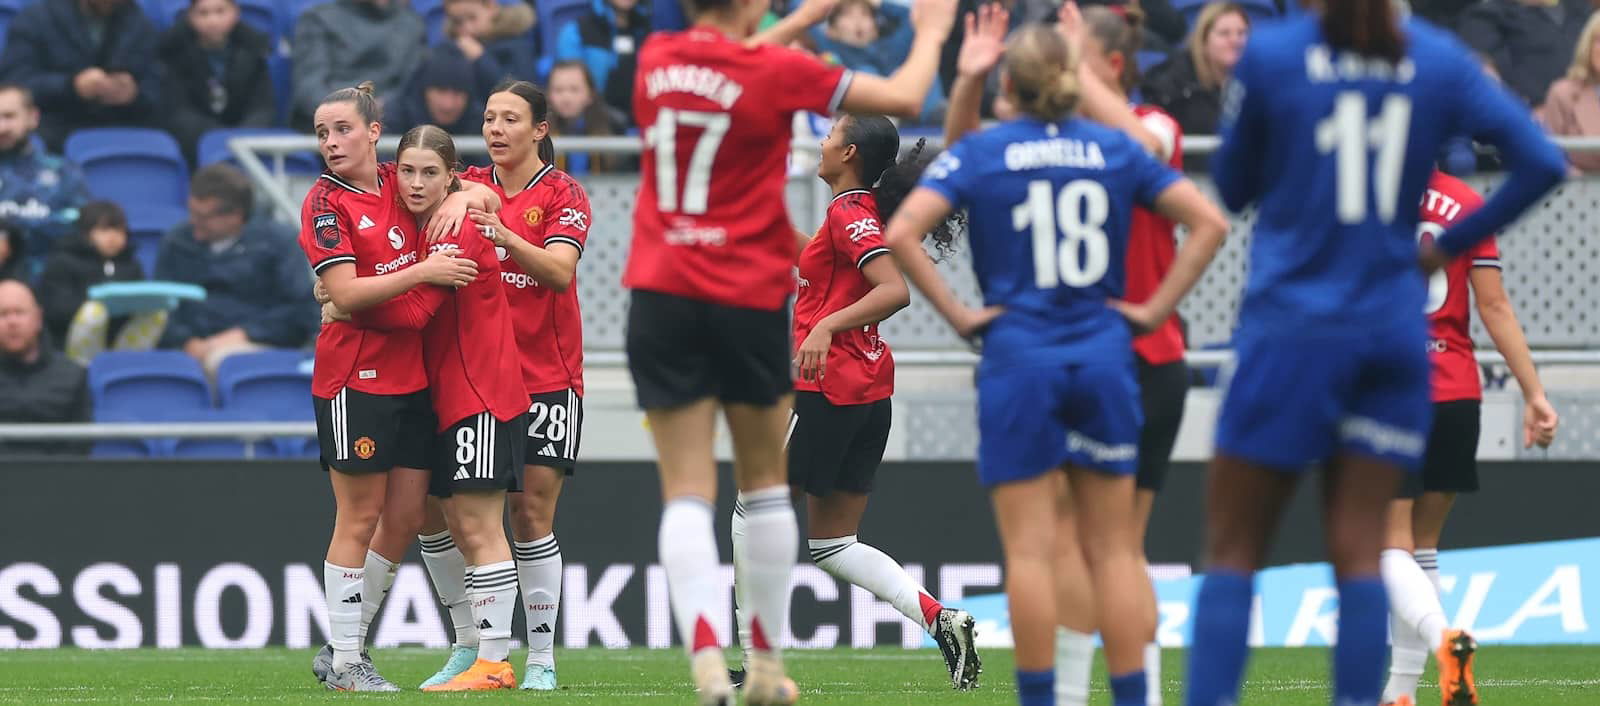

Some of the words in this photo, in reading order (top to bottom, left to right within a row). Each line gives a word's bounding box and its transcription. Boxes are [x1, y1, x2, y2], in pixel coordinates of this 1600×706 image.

[645, 64, 743, 110] JANSSEN
[644, 106, 731, 214] 17
[1004, 138, 1106, 171] ORNELLA
[1314, 91, 1412, 225] 11
[1420, 188, 1461, 221] TTI
[1012, 179, 1109, 289] 18
[528, 402, 567, 442] 28
[456, 426, 475, 465] 8
